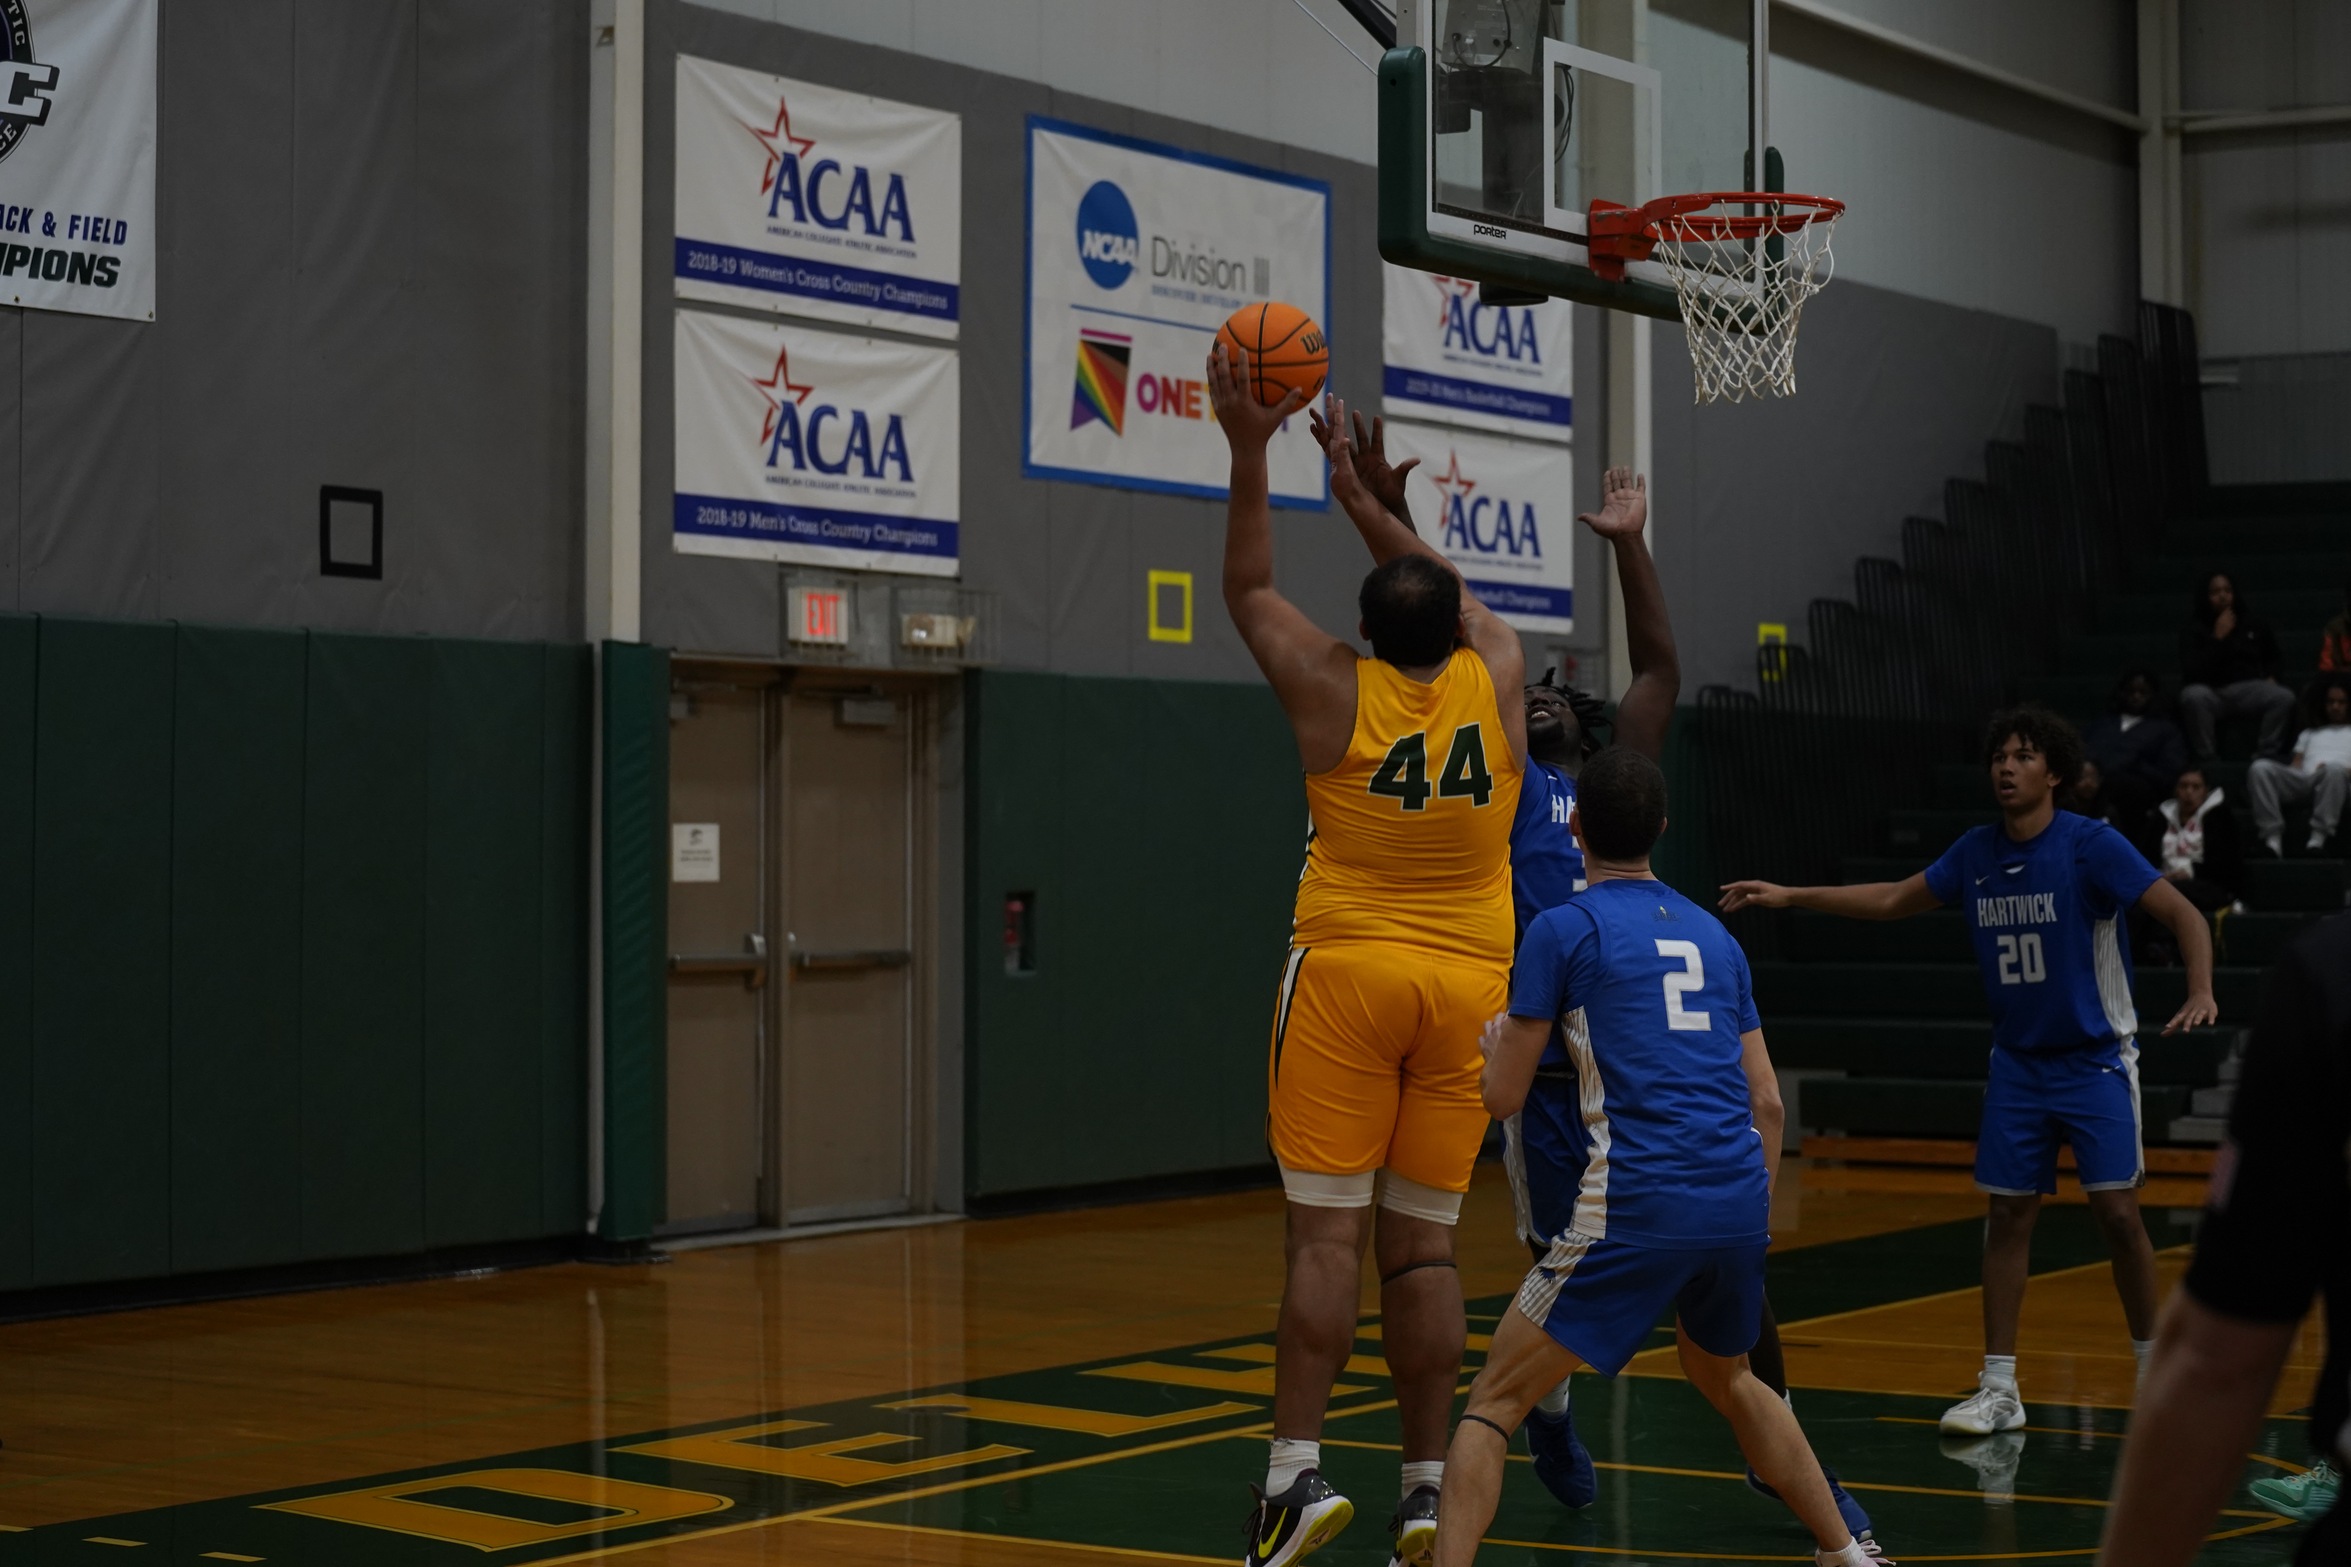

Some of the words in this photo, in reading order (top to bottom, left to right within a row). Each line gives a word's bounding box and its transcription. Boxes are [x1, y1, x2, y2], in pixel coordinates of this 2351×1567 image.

[768, 151, 916, 243] ACAA
[42, 211, 57, 238] &
[68, 214, 128, 246] FIELD
[1081, 229, 1138, 266] NCAA
[687, 251, 737, 275] 2018-19
[739, 258, 795, 285] Women's
[795, 269, 830, 290] Cross
[832, 274, 882, 302] Country
[883, 283, 949, 311] Champions
[1152, 235, 1247, 293] Division
[1444, 293, 1541, 364] ACAA
[1137, 372, 1202, 419] ONE
[767, 400, 914, 482] ACAA
[696, 506, 747, 529] 2018-19
[748, 511, 787, 533] Men's
[788, 514, 821, 536] Cross
[821, 520, 872, 544] Country
[873, 524, 939, 549] Champions
[1445, 492, 1541, 557] ACAA
[1367, 720, 1495, 812] 44
[1977, 892, 2058, 928] HARTWICK
[1654, 938, 1712, 1031] 2
[1997, 932, 2047, 986] 20
